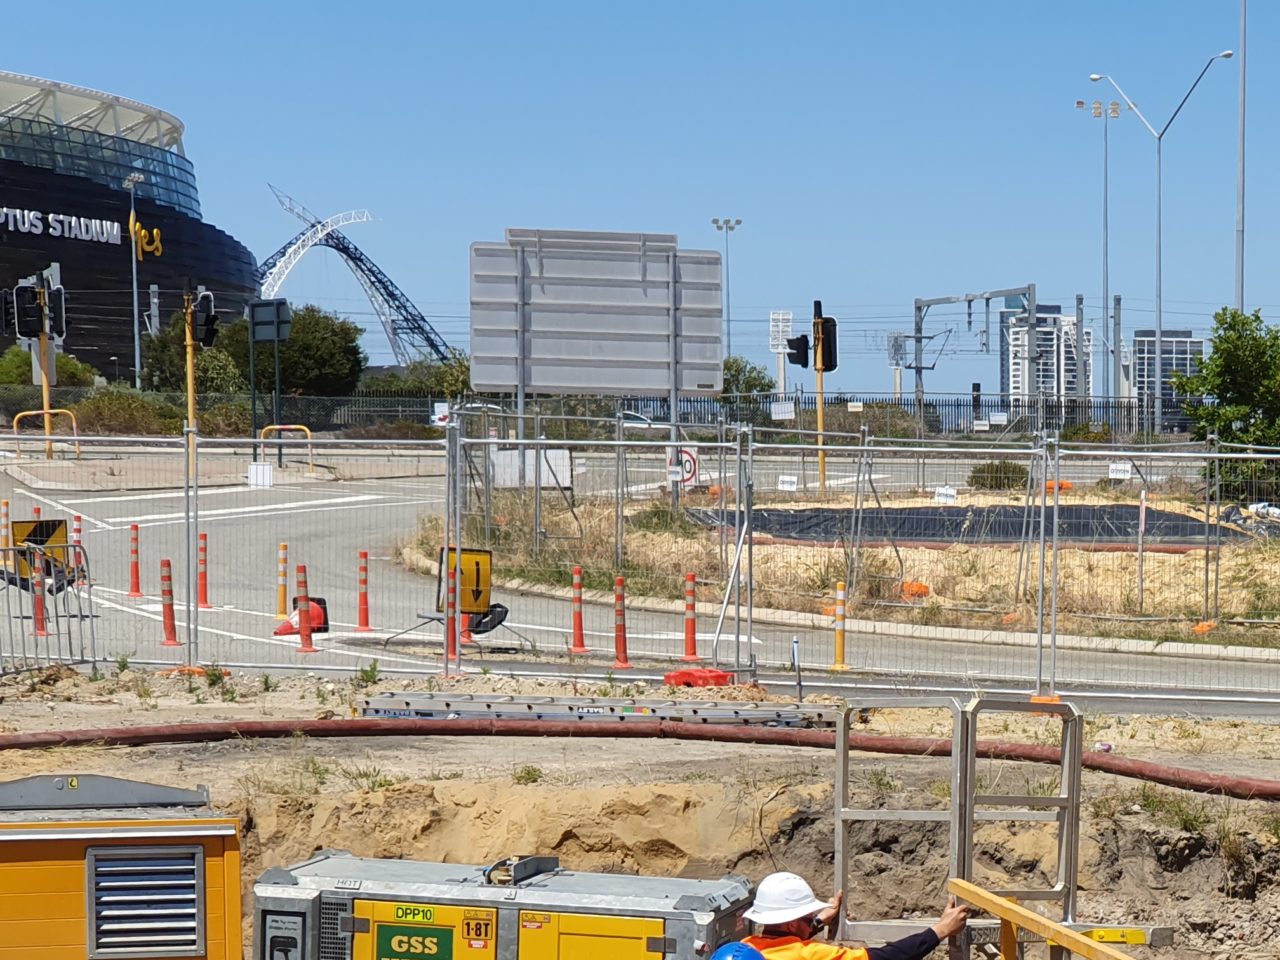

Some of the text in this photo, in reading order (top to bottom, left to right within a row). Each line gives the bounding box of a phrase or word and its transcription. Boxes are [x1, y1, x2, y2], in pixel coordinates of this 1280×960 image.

[0, 207, 121, 245] TUS STADIUM
[396, 907, 432, 920] DPP10
[391, 935, 437, 954] GSS
